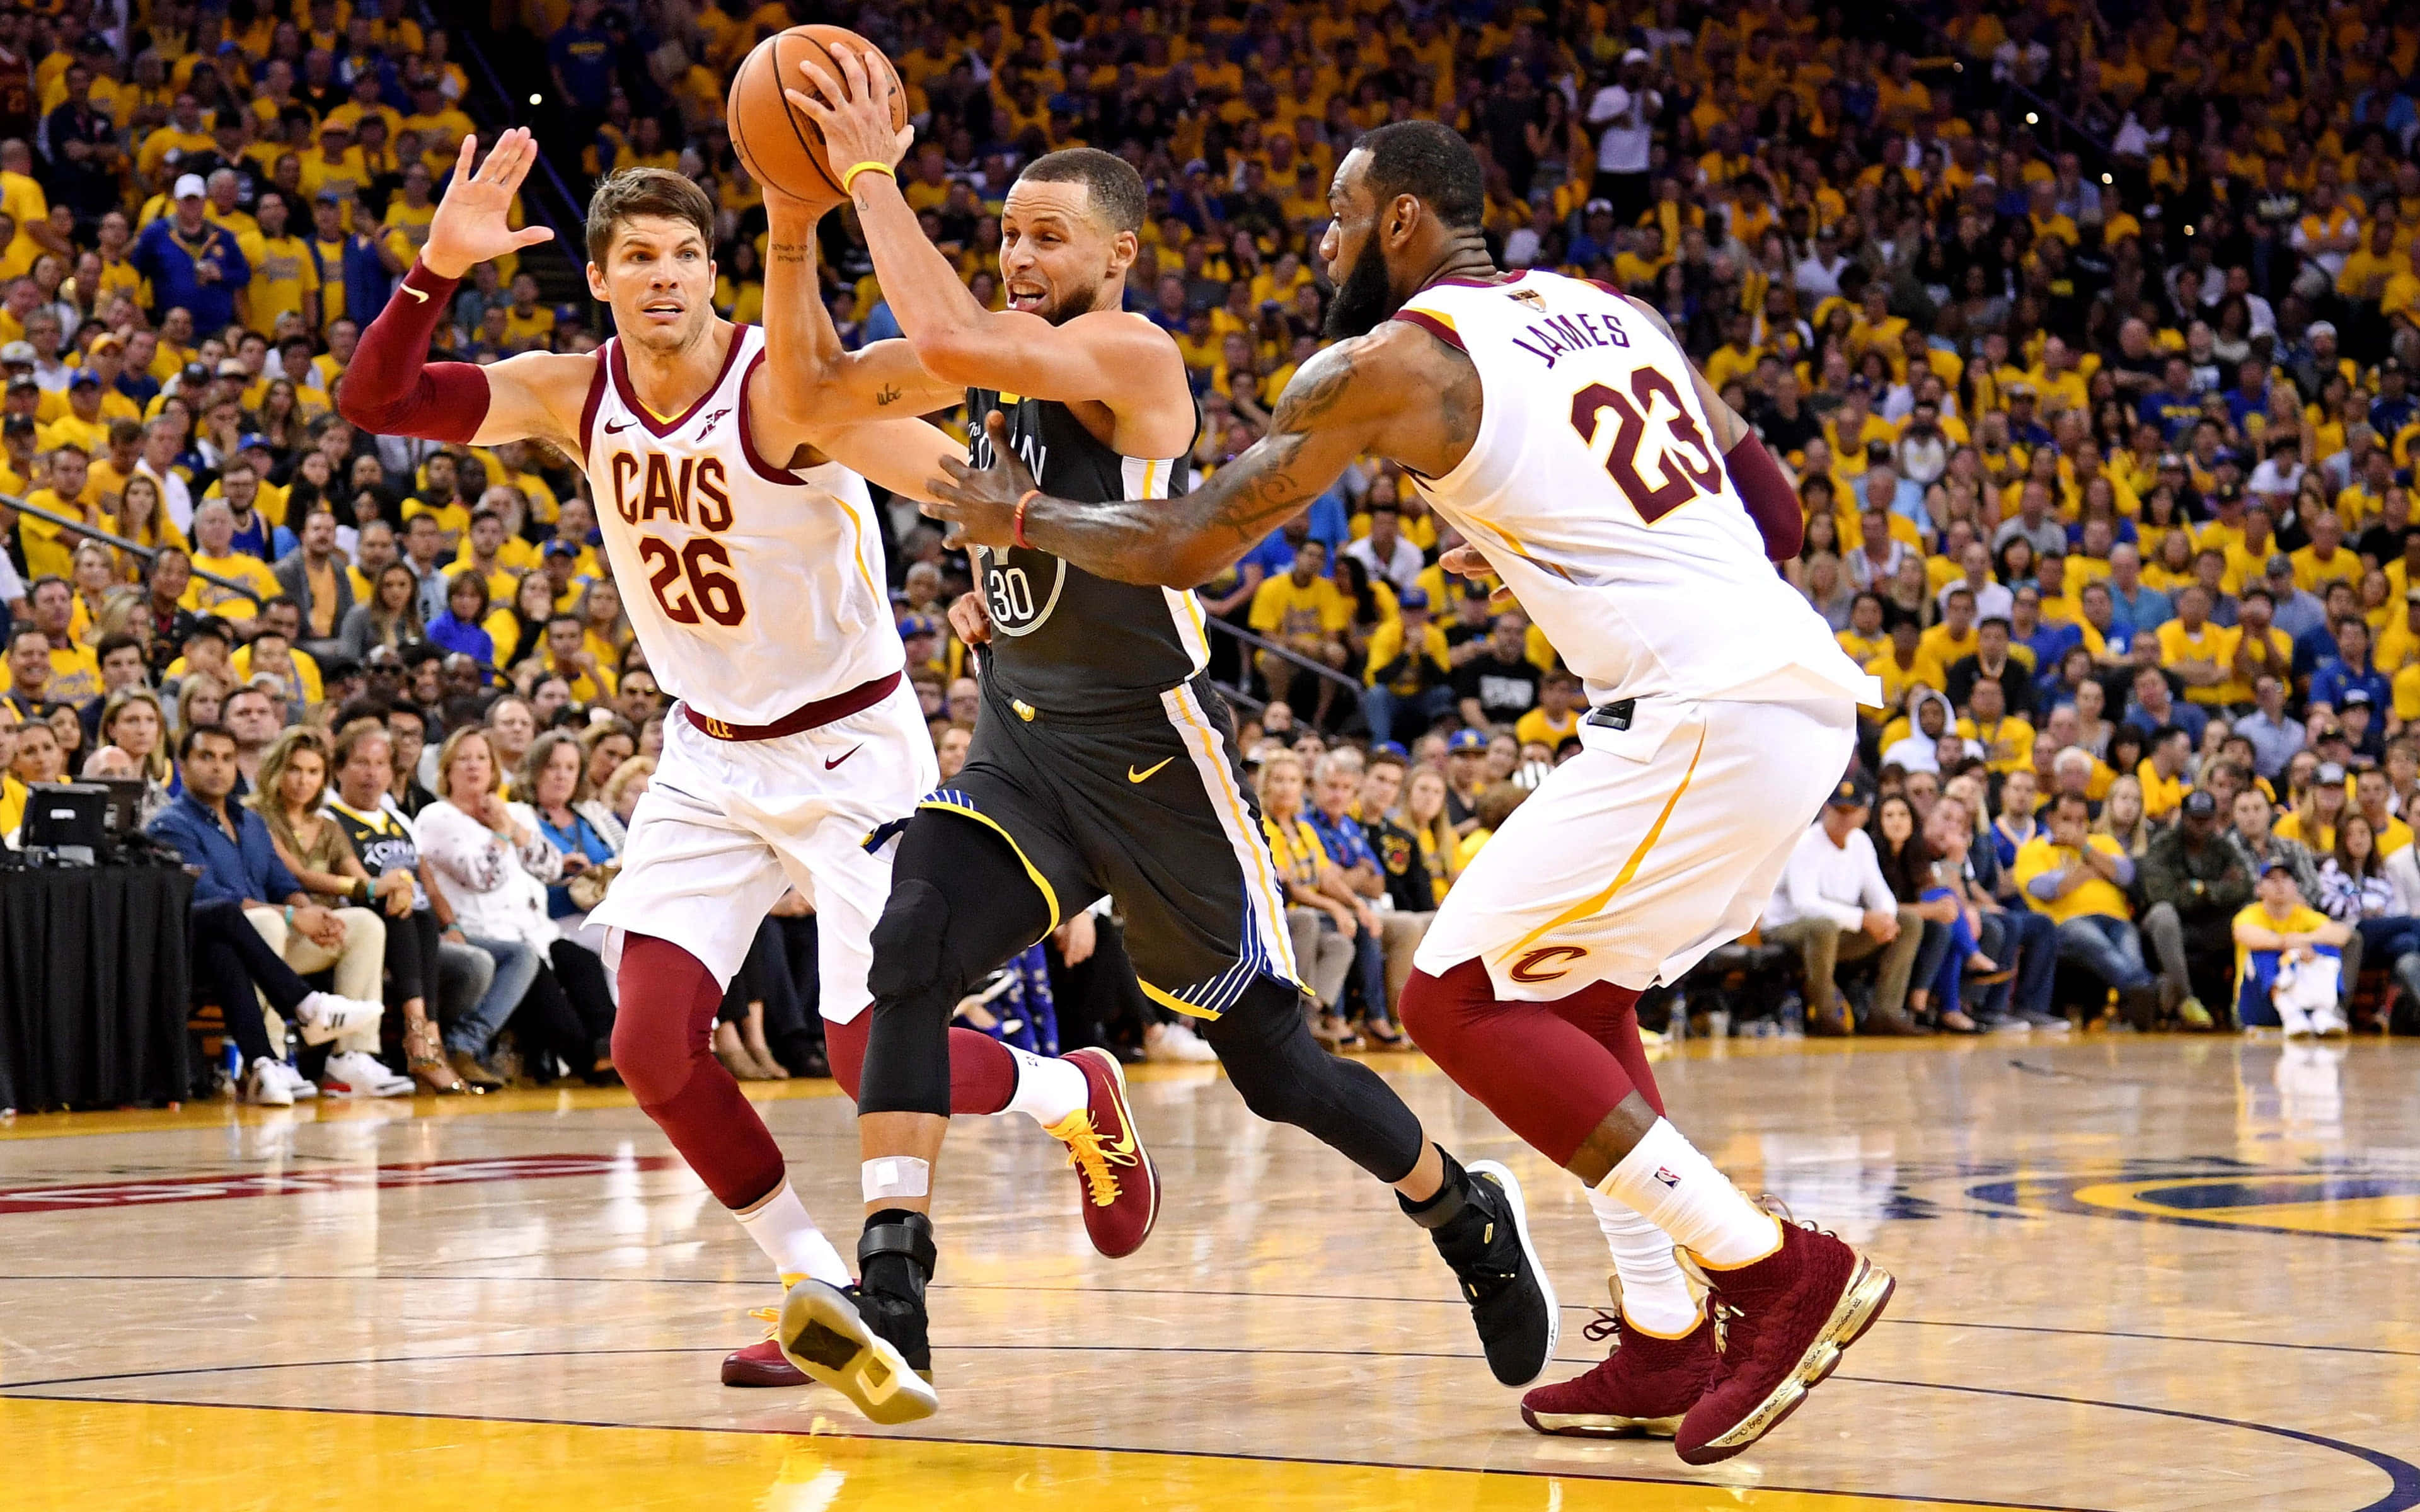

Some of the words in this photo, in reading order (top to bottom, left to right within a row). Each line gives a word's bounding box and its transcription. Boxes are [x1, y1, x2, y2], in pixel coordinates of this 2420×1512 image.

[1512, 313, 1630, 370] JAMES
[1569, 364, 1722, 527] 23
[611, 450, 735, 534] CAVS
[638, 536, 747, 627] 26
[989, 568, 1035, 622] 30
[706, 716, 734, 738] CLE
